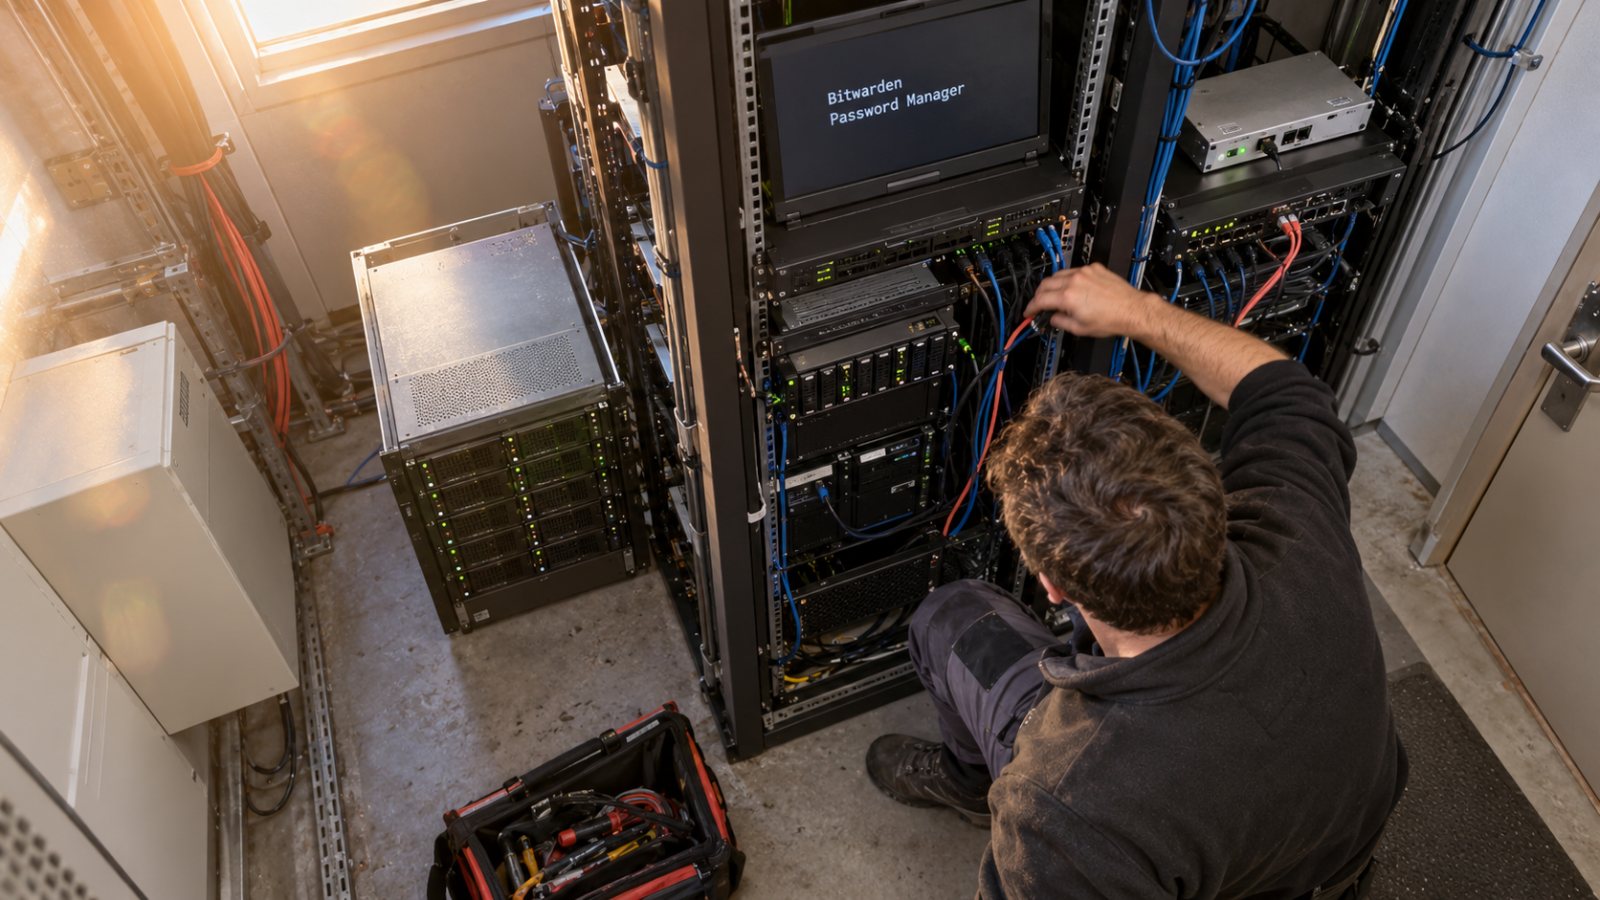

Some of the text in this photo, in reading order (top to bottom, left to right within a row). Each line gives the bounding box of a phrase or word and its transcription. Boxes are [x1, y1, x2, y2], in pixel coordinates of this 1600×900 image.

[827, 79, 903, 105] Bitwarden
[829, 84, 965, 126] Password Manager
